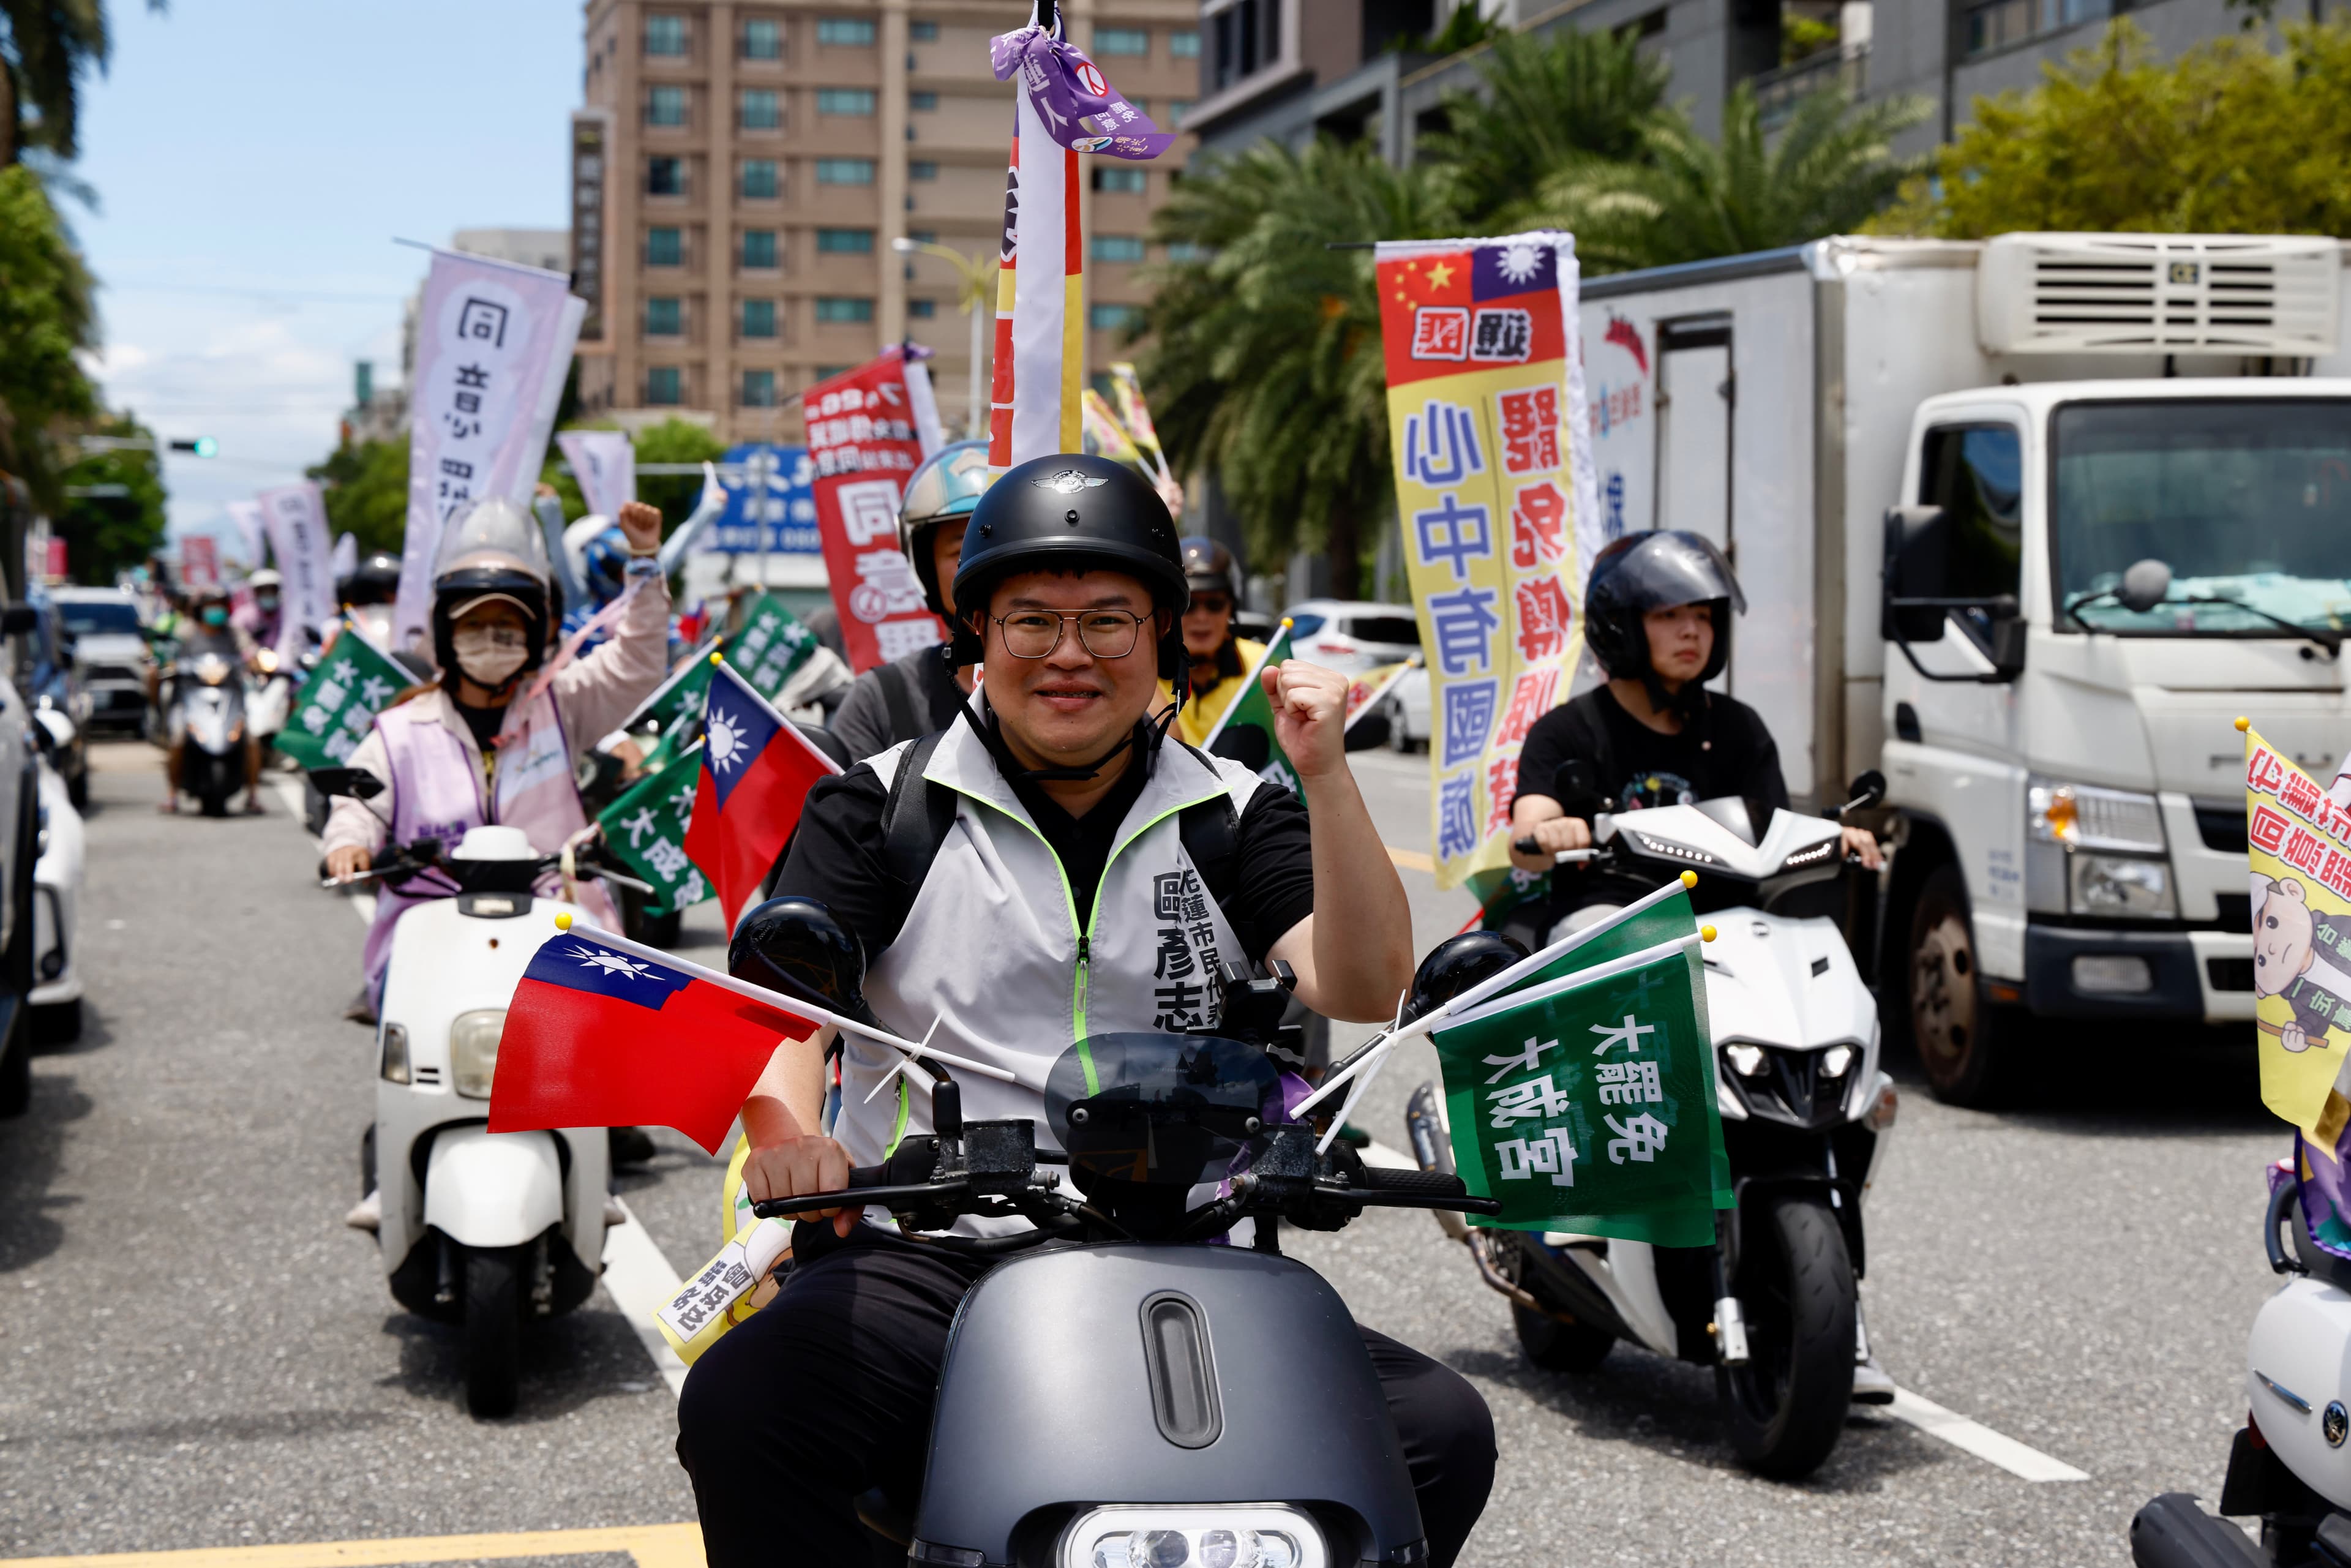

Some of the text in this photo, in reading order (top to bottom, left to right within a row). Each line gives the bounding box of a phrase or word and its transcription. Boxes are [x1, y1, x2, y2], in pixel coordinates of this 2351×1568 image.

[1482, 1035, 1579, 1188] 大成宮
[1589, 1014, 1668, 1165] 大罷免
